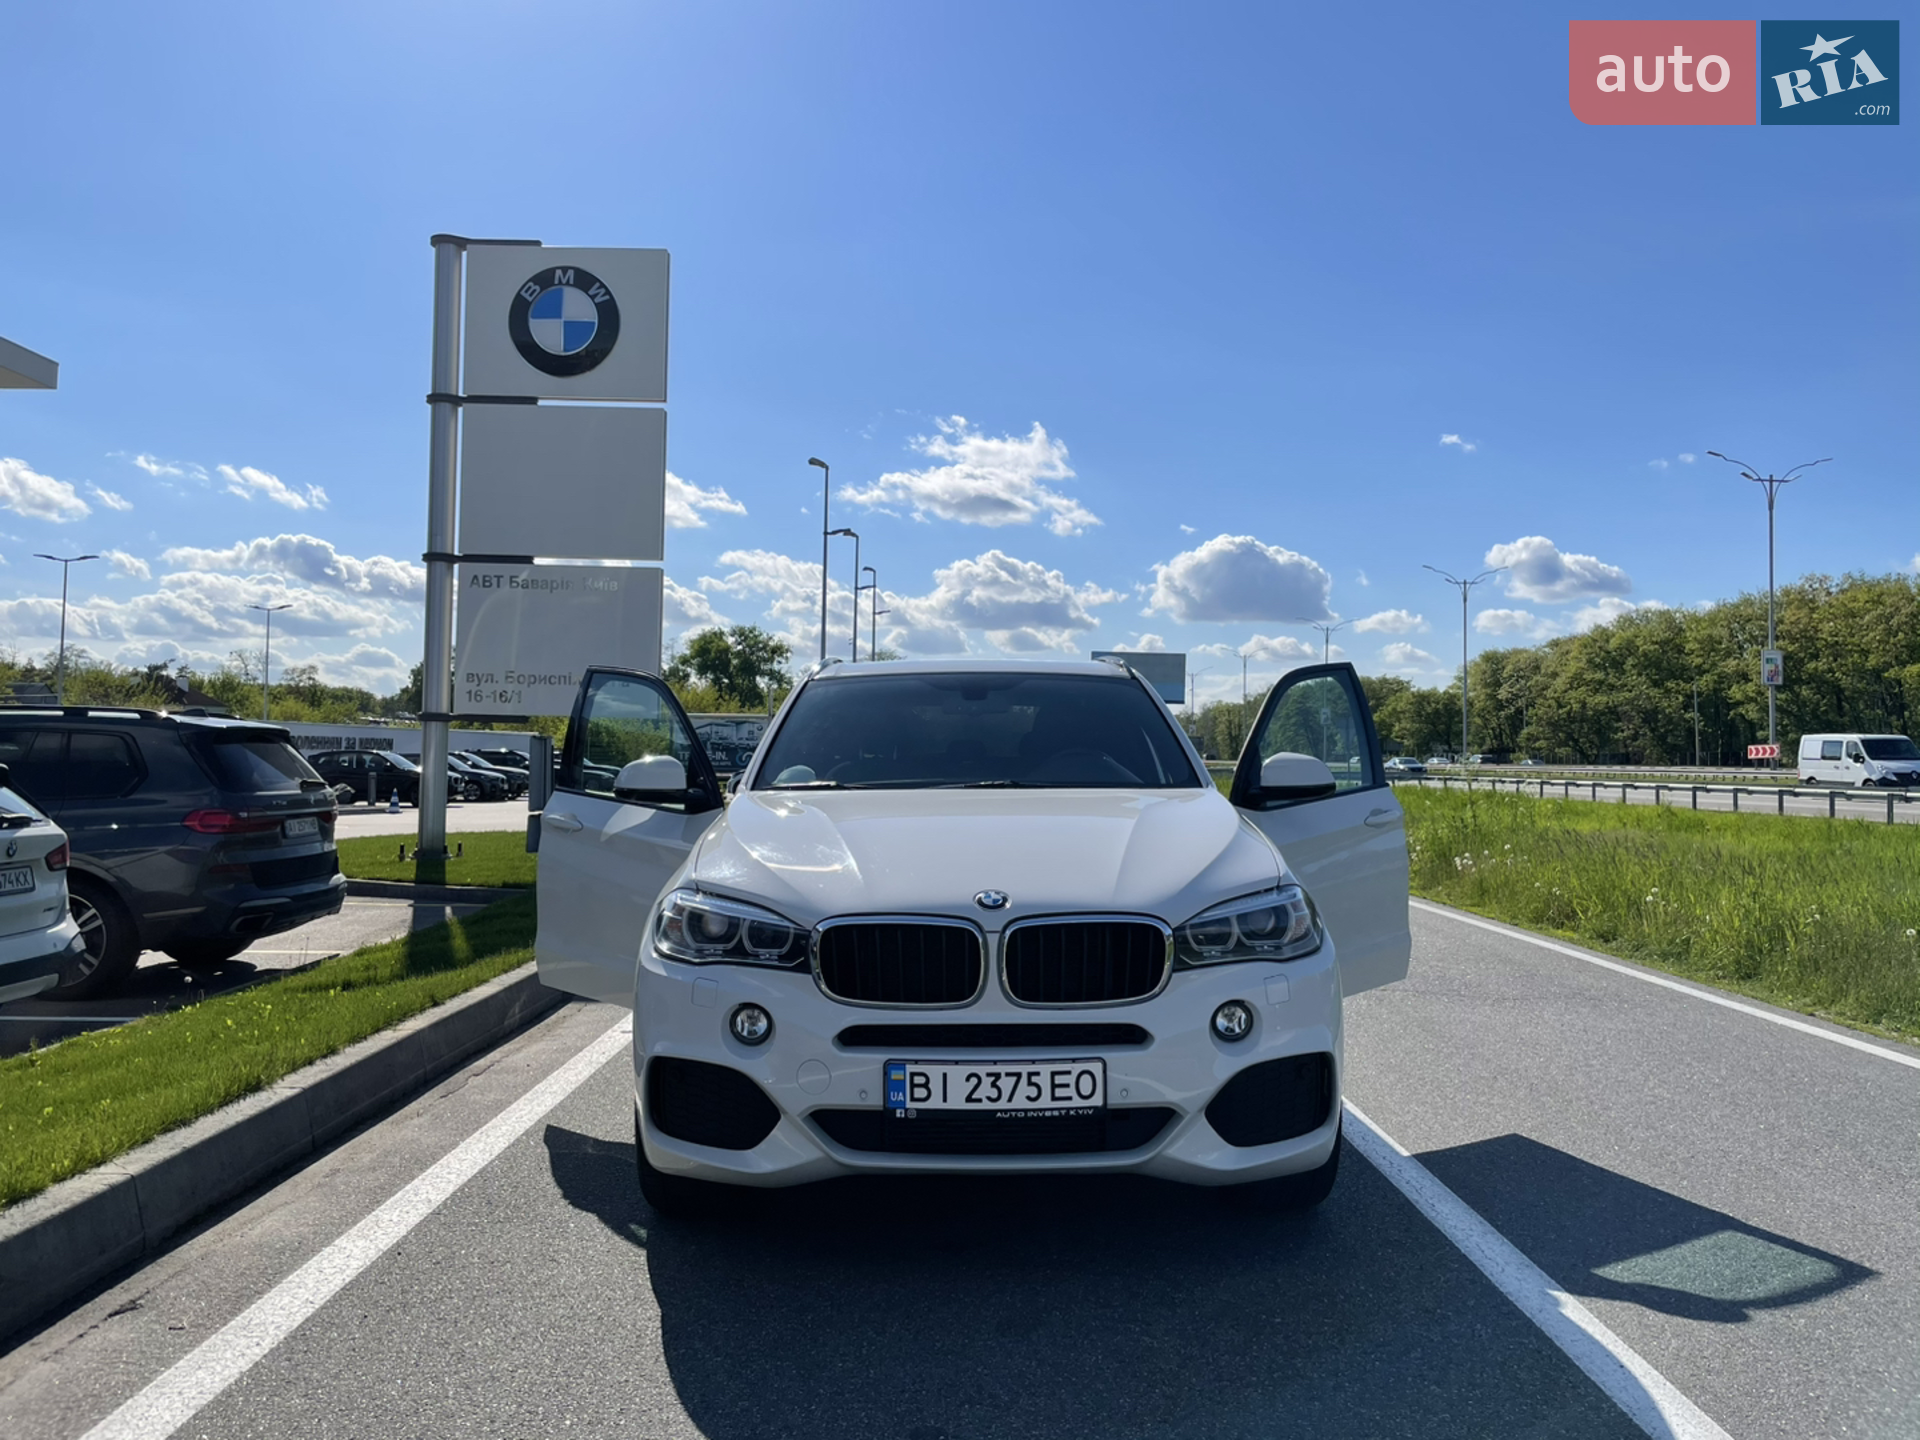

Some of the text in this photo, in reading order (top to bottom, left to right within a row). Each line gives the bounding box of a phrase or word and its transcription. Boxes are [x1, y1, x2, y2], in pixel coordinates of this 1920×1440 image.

[519, 268, 610, 304] BMW
[469, 574, 504, 589] АВТ
[508, 575, 574, 594] Баварія
[466, 672, 499, 687] вул.
[466, 689, 522, 703] 16-16/1
[0, 870, 30, 890] 74KX
[890, 1091, 904, 1101] UA
